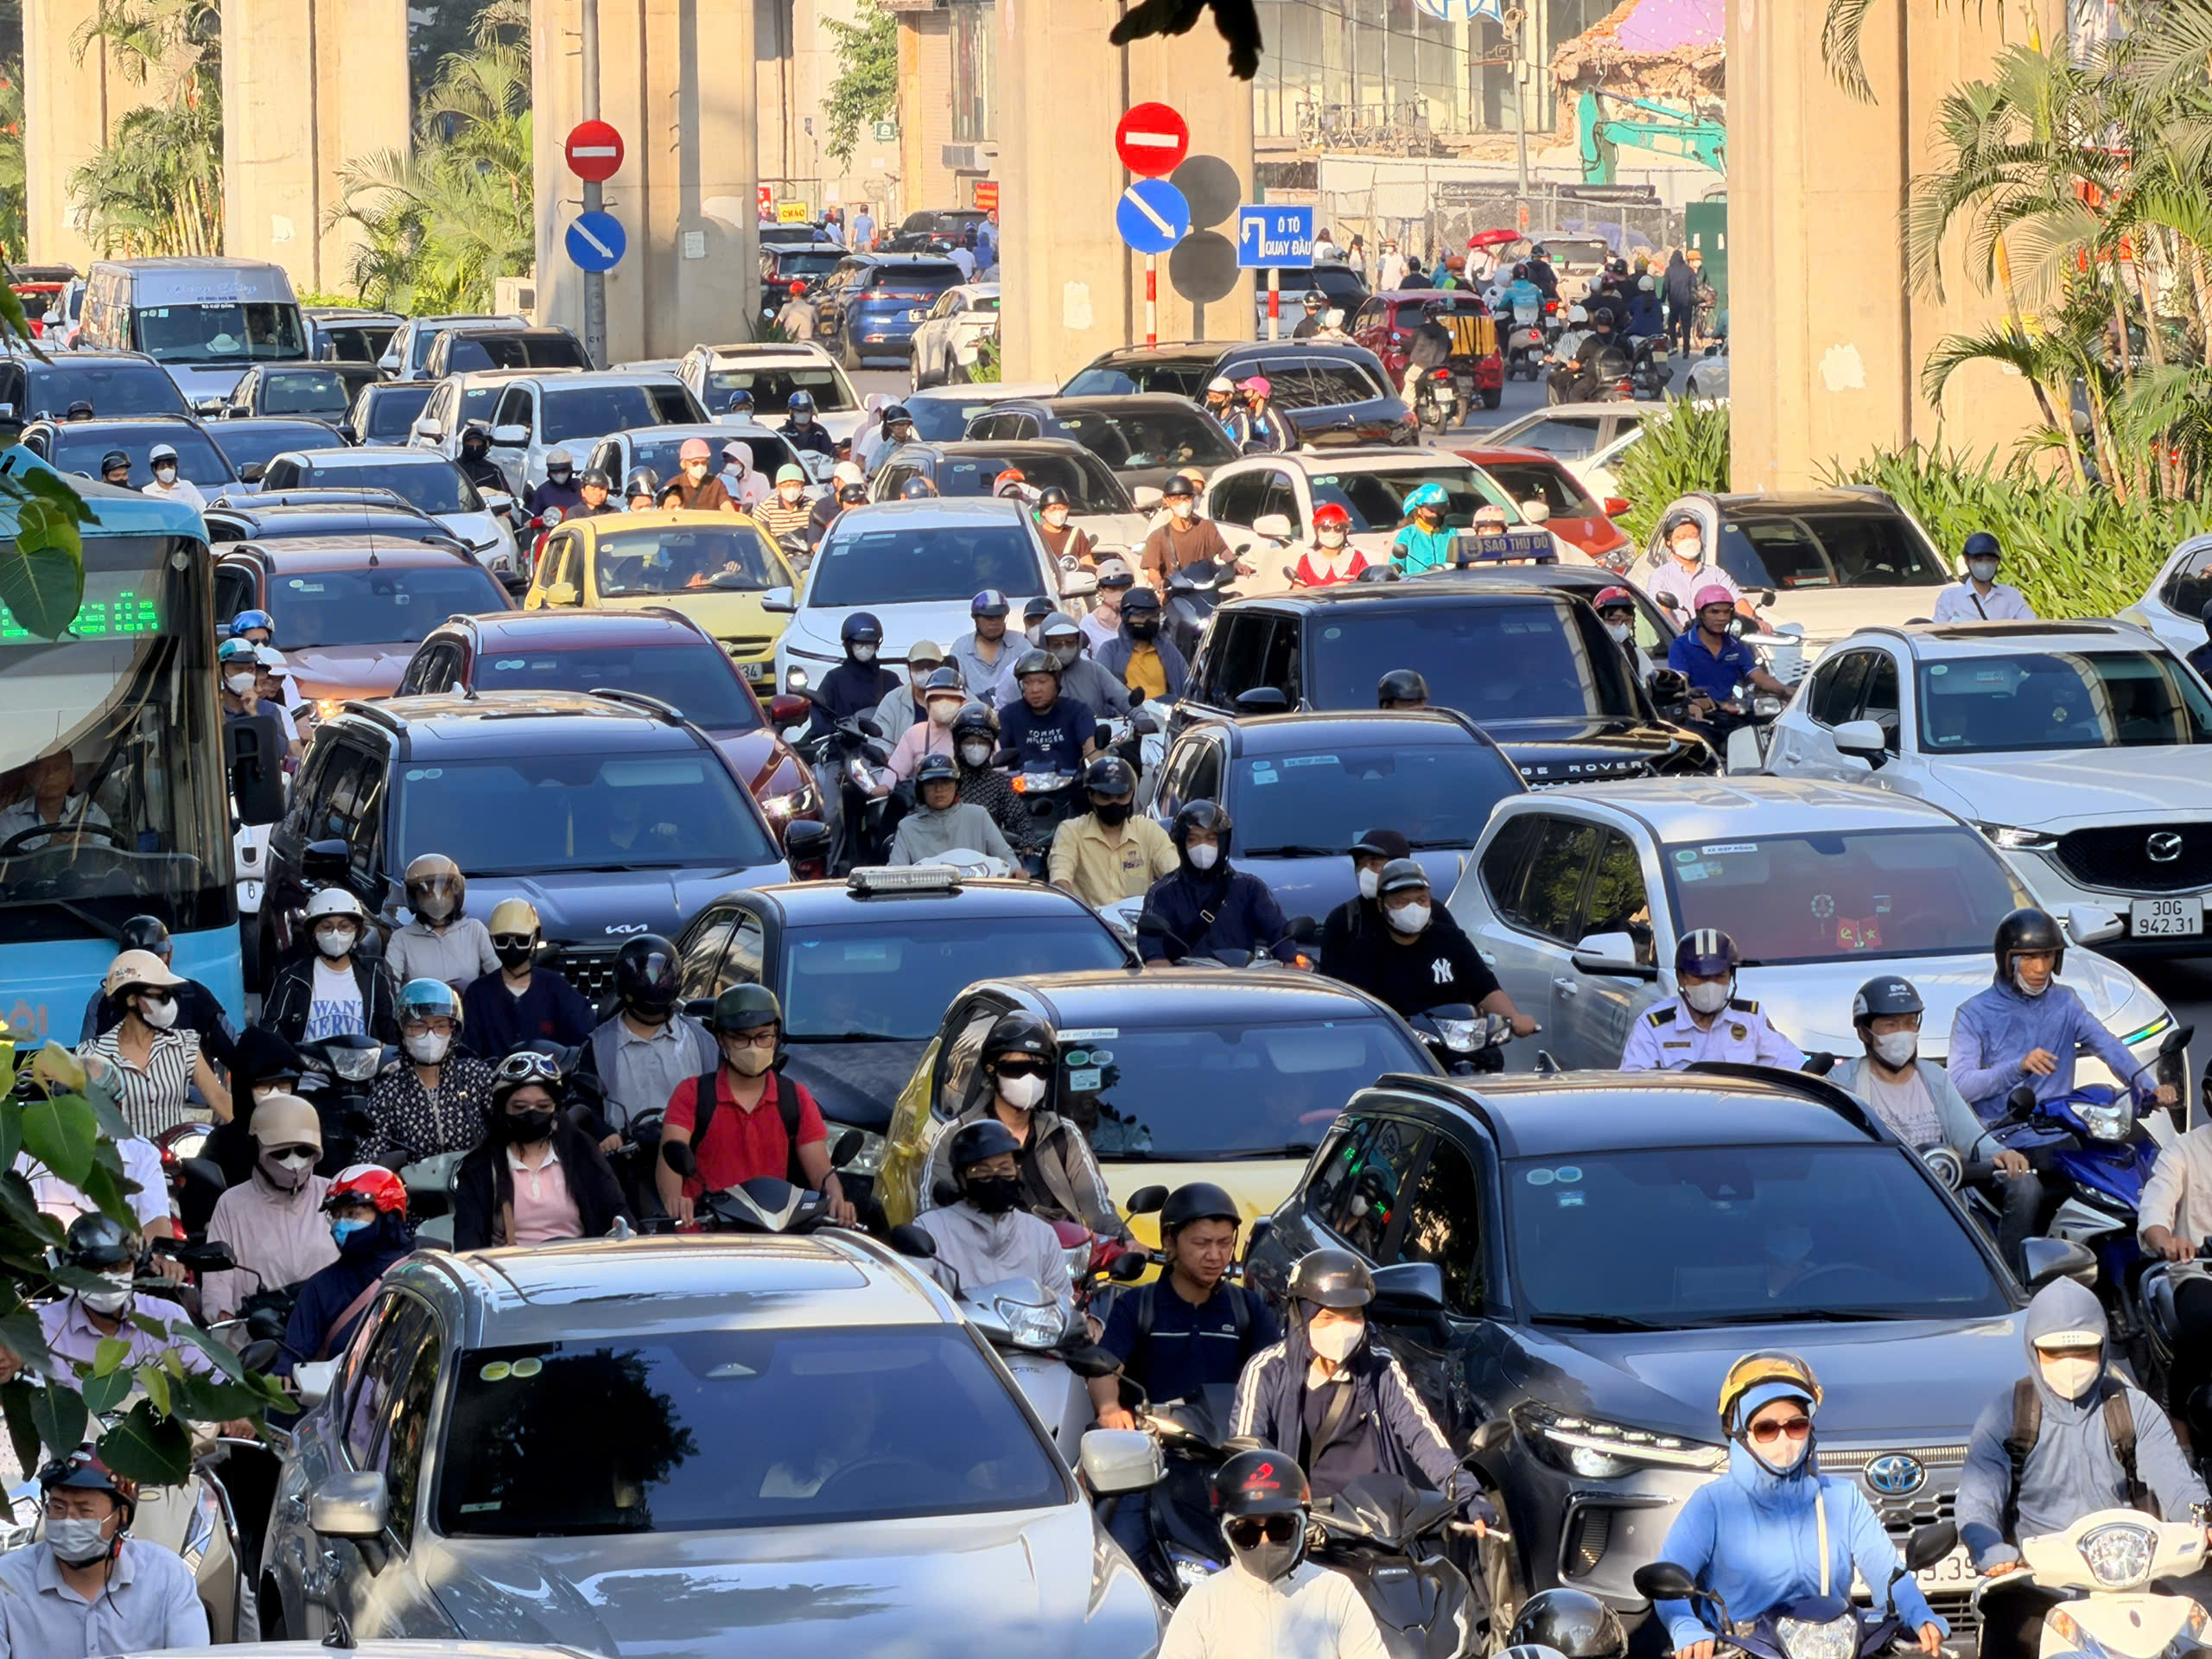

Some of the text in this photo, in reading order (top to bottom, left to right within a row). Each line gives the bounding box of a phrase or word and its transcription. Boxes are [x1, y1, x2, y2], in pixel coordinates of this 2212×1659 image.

[1265, 235, 1312, 256] QUAY ĐẦU
[1484, 537, 1507, 553] SAO
[1029, 728, 1061, 738] TOMMY
[1568, 760, 1643, 773] ROVER
[2152, 900, 2182, 916] 30G
[2139, 917, 2193, 934] 942.31
